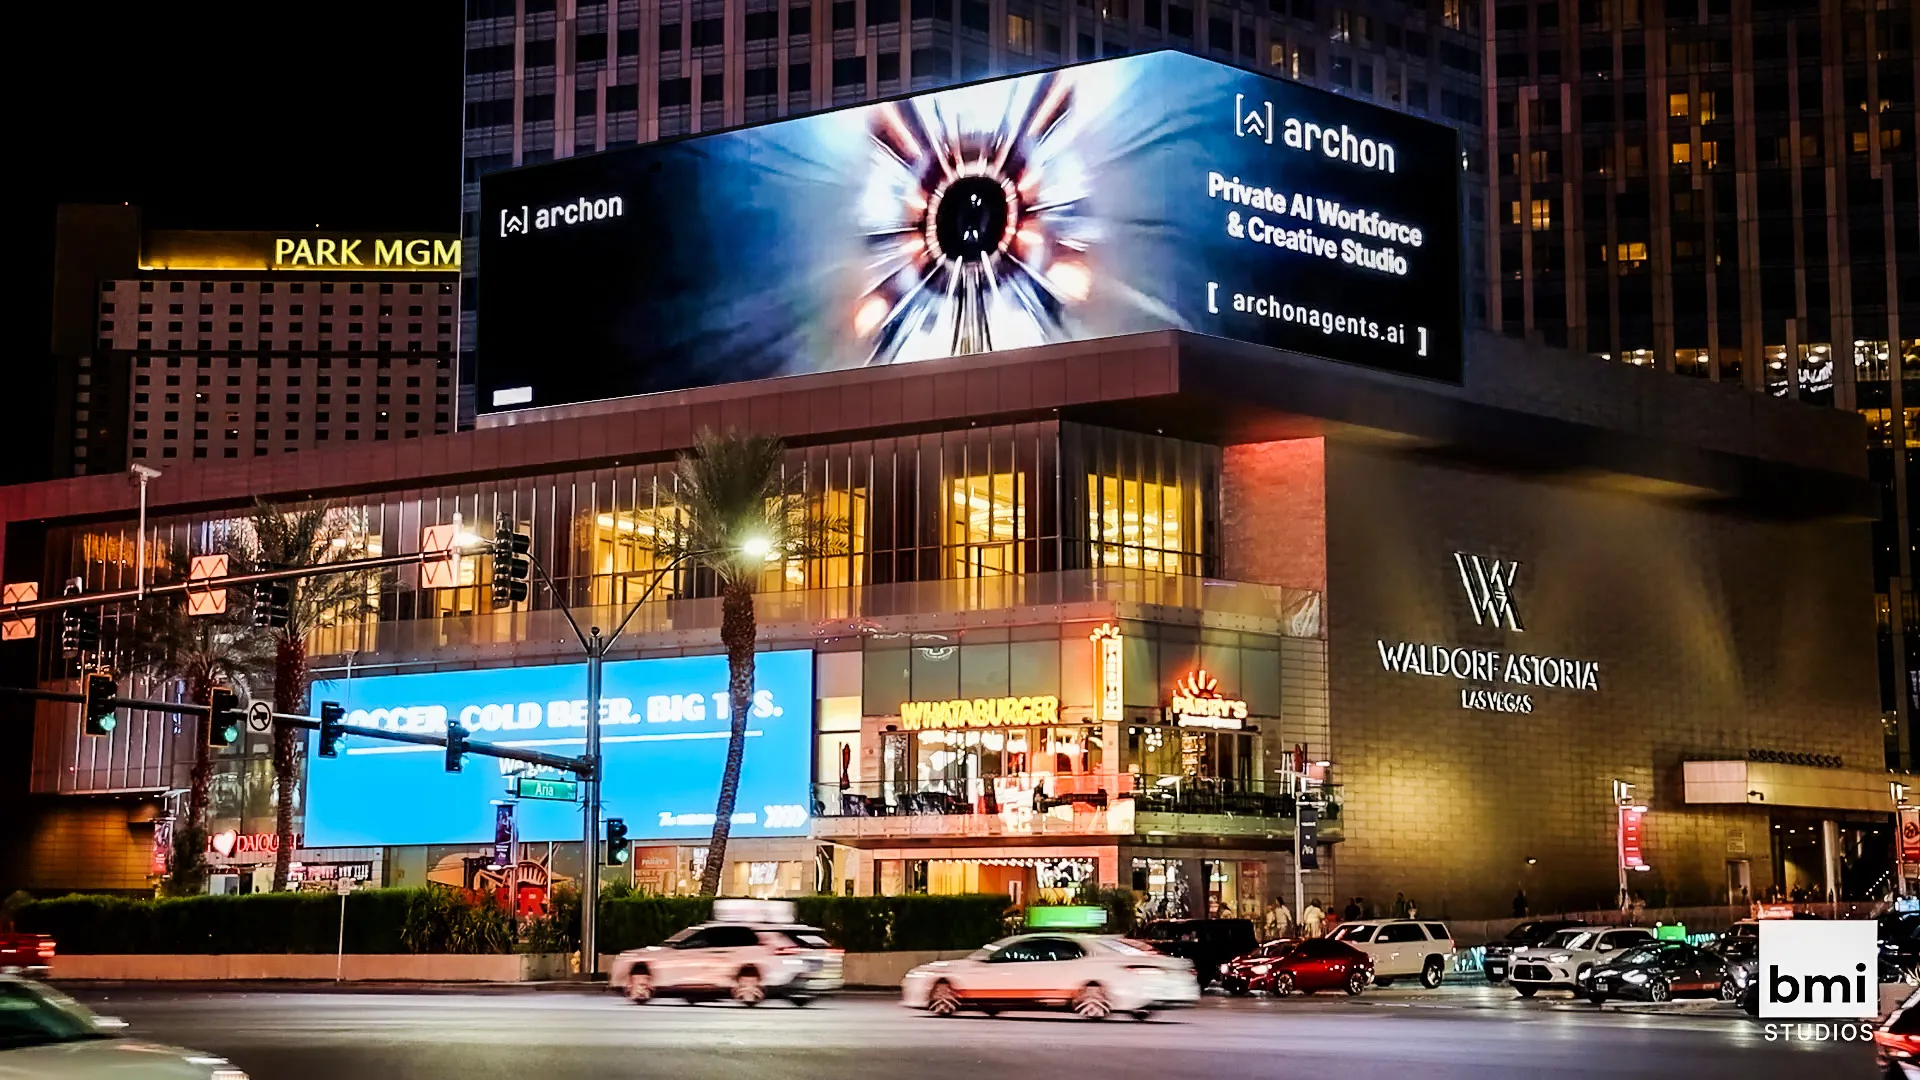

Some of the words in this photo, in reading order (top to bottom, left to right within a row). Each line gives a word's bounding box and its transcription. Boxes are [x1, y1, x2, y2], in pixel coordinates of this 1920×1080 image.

[1284, 118, 1395, 173] archon
[535, 195, 623, 230] archon
[1208, 171, 1287, 214] Private
[1290, 193, 1313, 221] AI
[1316, 198, 1423, 247] Workforce
[276, 238, 364, 266] PARK
[374, 239, 462, 266] MGM
[1227, 211, 1245, 239] &
[1247, 216, 1338, 259] Creative
[1341, 238, 1407, 275] Studio
[1233, 293, 1405, 345] archonagents.ai
[1377, 639, 1501, 682] WALDORF
[1504, 654, 1599, 691] ASTORIA
[460, 701, 543, 732] COLD
[647, 693, 705, 723] BIG
[901, 695, 1059, 730] WHATABURGER
[1461, 689, 1487, 710] LAS
[1486, 691, 1533, 714] VEGAS
[535, 782, 554, 797] Aria
